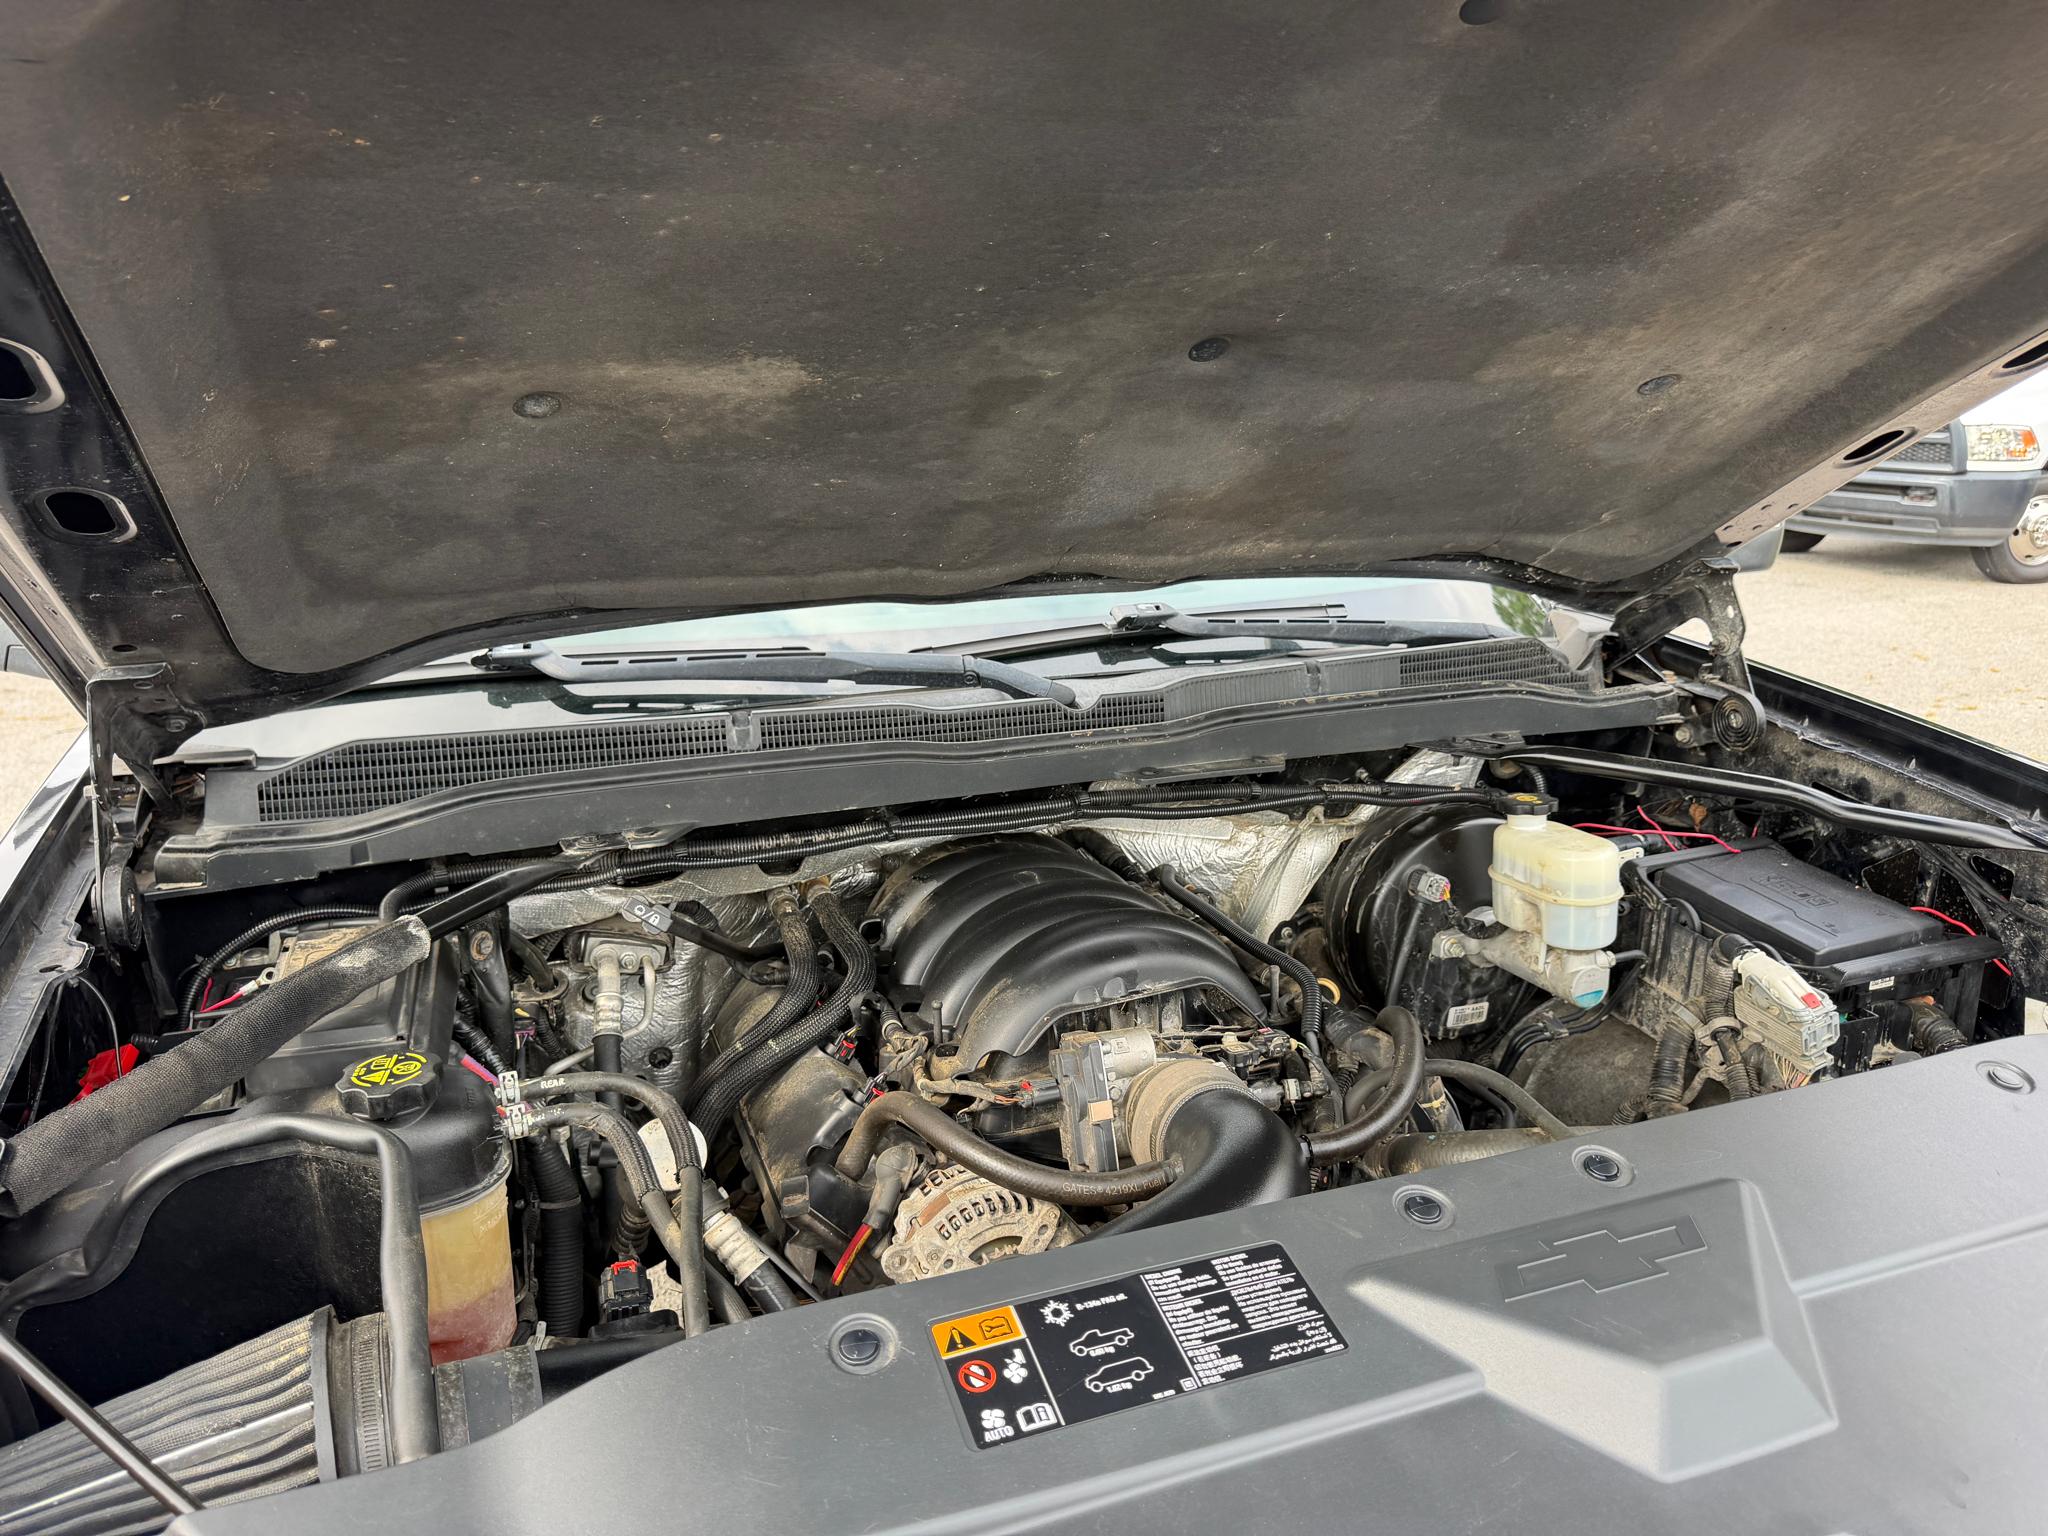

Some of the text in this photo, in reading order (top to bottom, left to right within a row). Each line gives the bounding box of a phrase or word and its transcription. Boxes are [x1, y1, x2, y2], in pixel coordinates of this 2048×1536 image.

[540, 1077, 566, 1089] REAR
[1105, 1184, 1140, 1196] 4219XL
[984, 1425, 1014, 1442] AUTO
